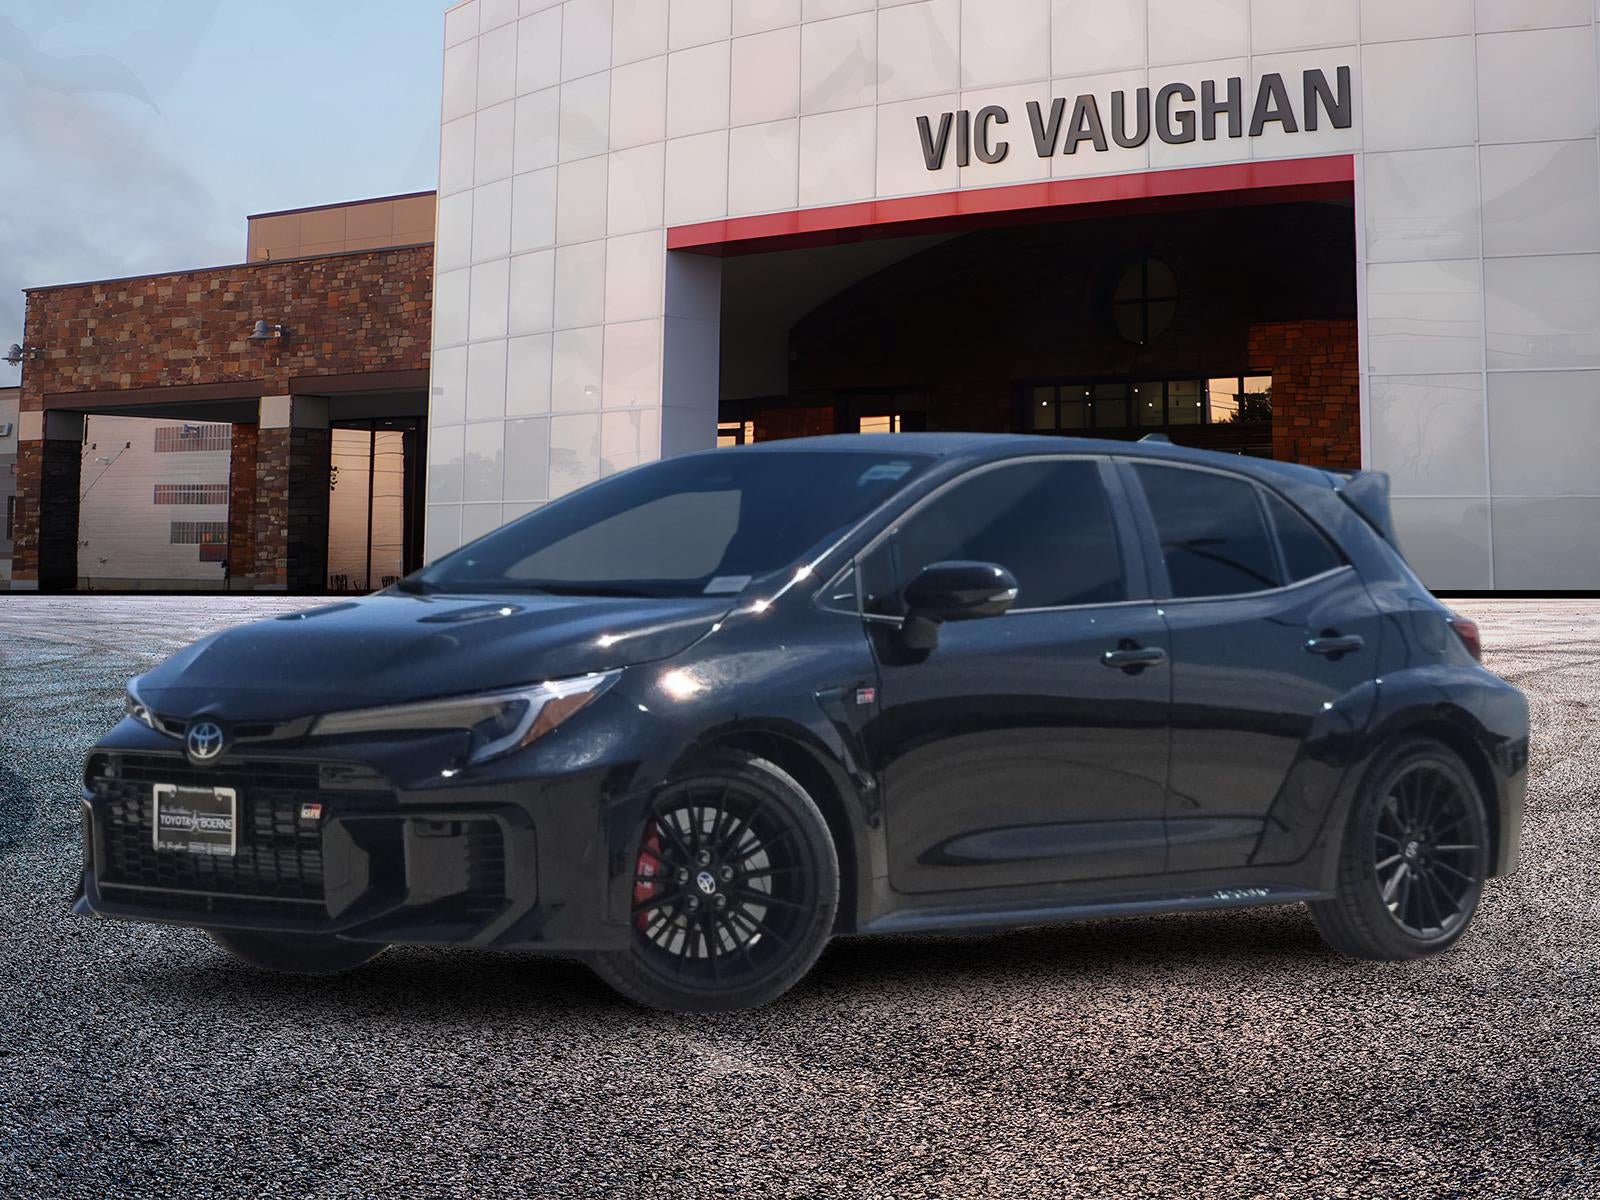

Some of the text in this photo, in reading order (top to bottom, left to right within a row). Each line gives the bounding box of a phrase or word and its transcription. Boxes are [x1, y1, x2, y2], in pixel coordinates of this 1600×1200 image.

[916, 65, 1353, 171] VIC VAUGHAN
[160, 814, 232, 830] TOYOTA BOERNE
